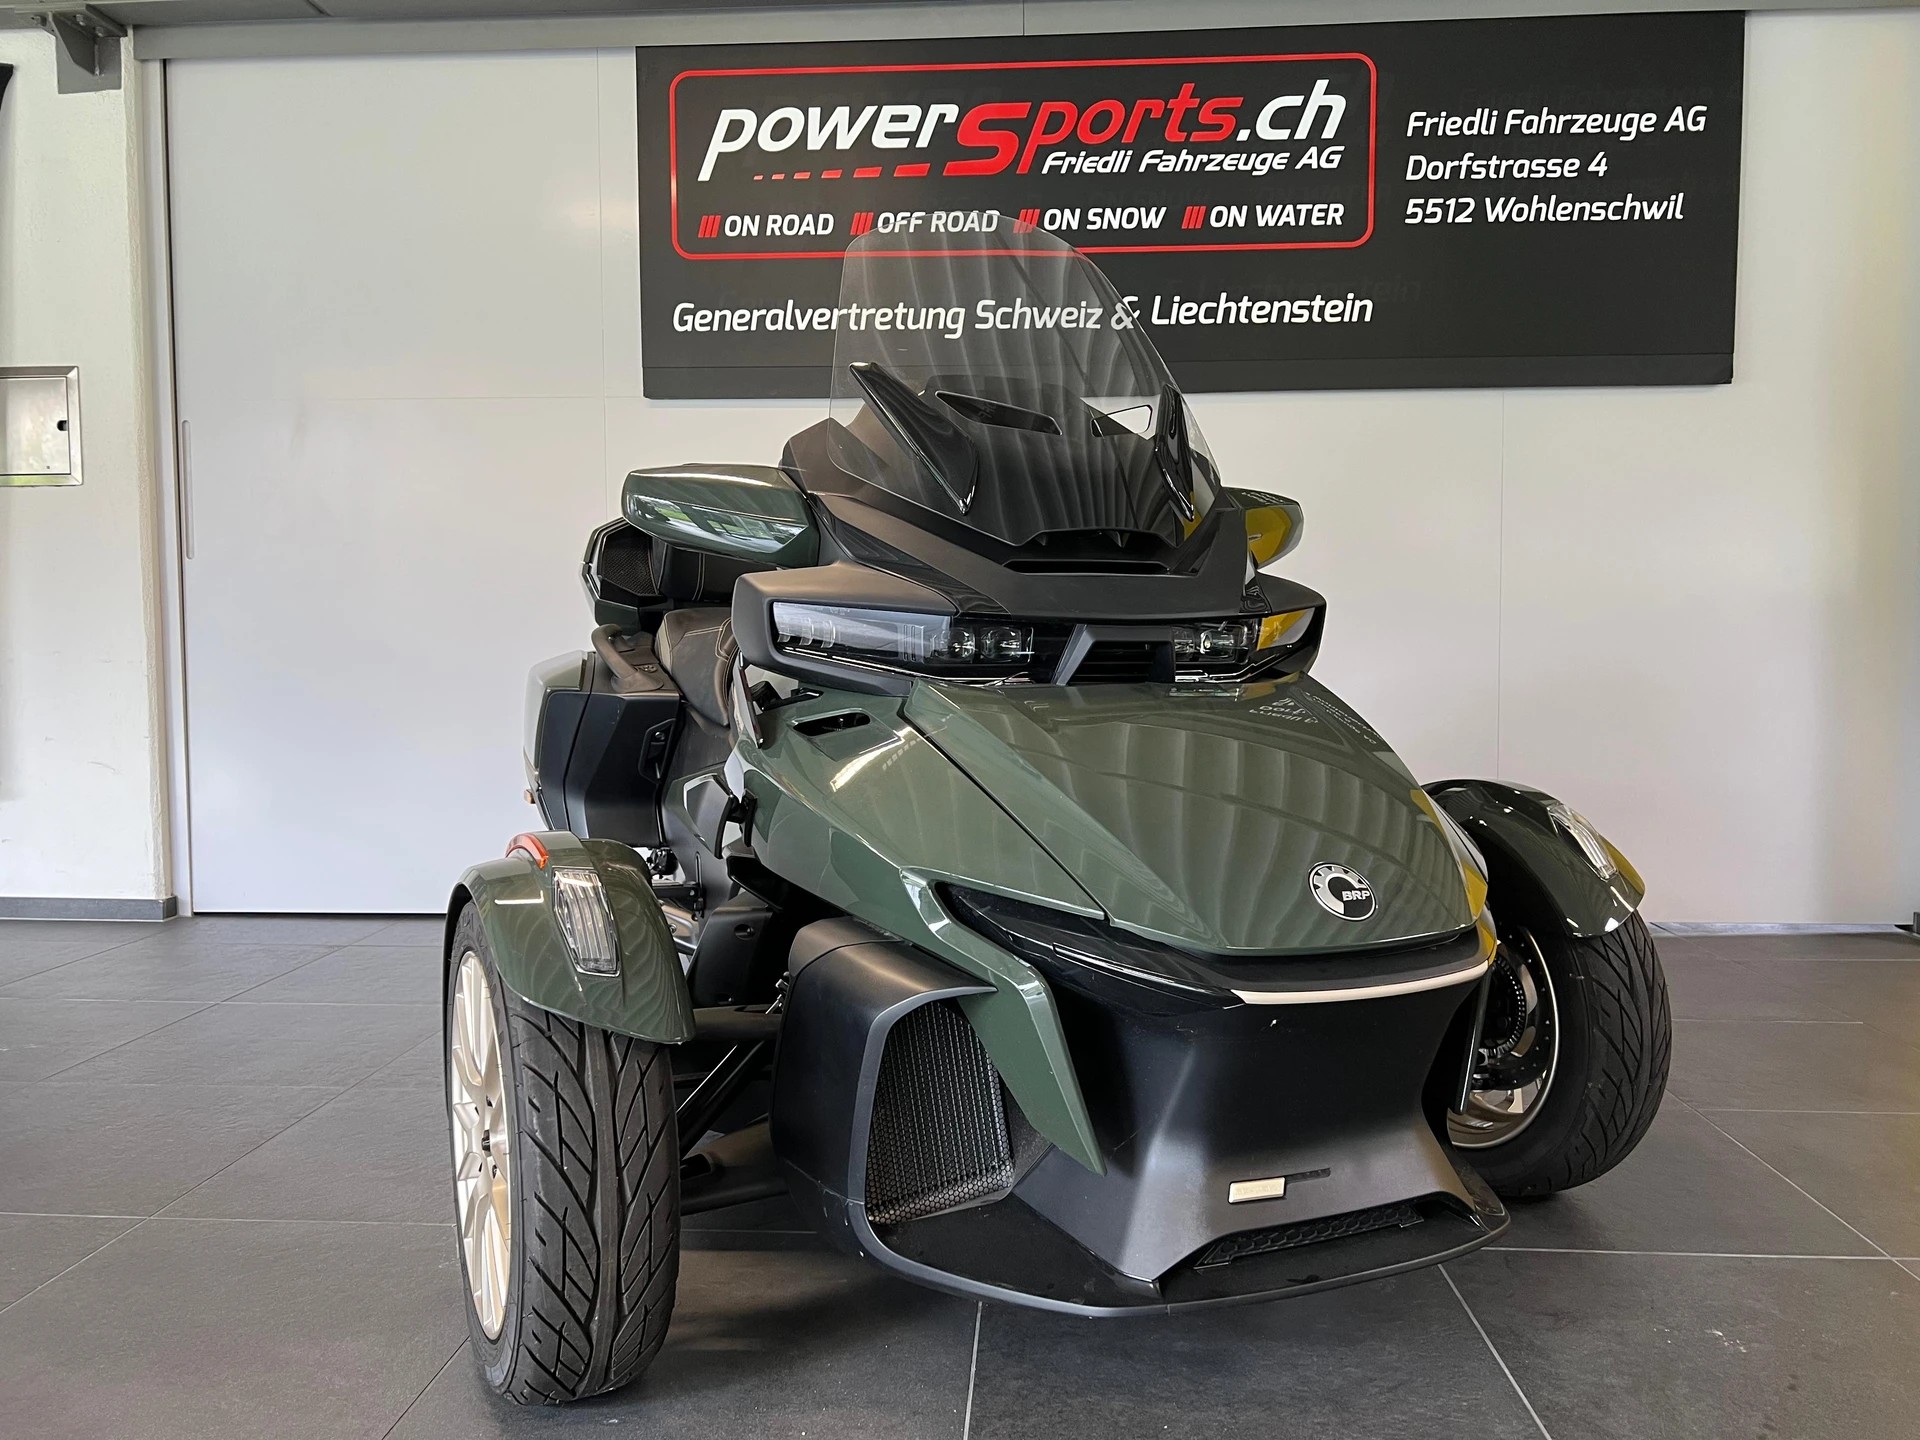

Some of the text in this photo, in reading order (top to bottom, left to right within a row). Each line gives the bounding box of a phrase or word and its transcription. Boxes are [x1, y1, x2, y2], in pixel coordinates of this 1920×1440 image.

[1406, 105, 1708, 141] Friedli Fahrzeuge AG
[1041, 146, 1345, 177] Friedli Fahrzeuge AG
[1405, 151, 1609, 181] Dorfstrasse 4
[877, 209, 1002, 234] OFF ROAD
[1043, 206, 1168, 230] ON SNOW
[1209, 203, 1346, 228] ON WATER
[1404, 192, 1685, 224] 5512 Wohlenschwil
[723, 213, 836, 237] ON ROAD
[672, 291, 1374, 339] Generalvertretung Schweiz & Liechtenstein
[1341, 889, 1371, 901] BRP
